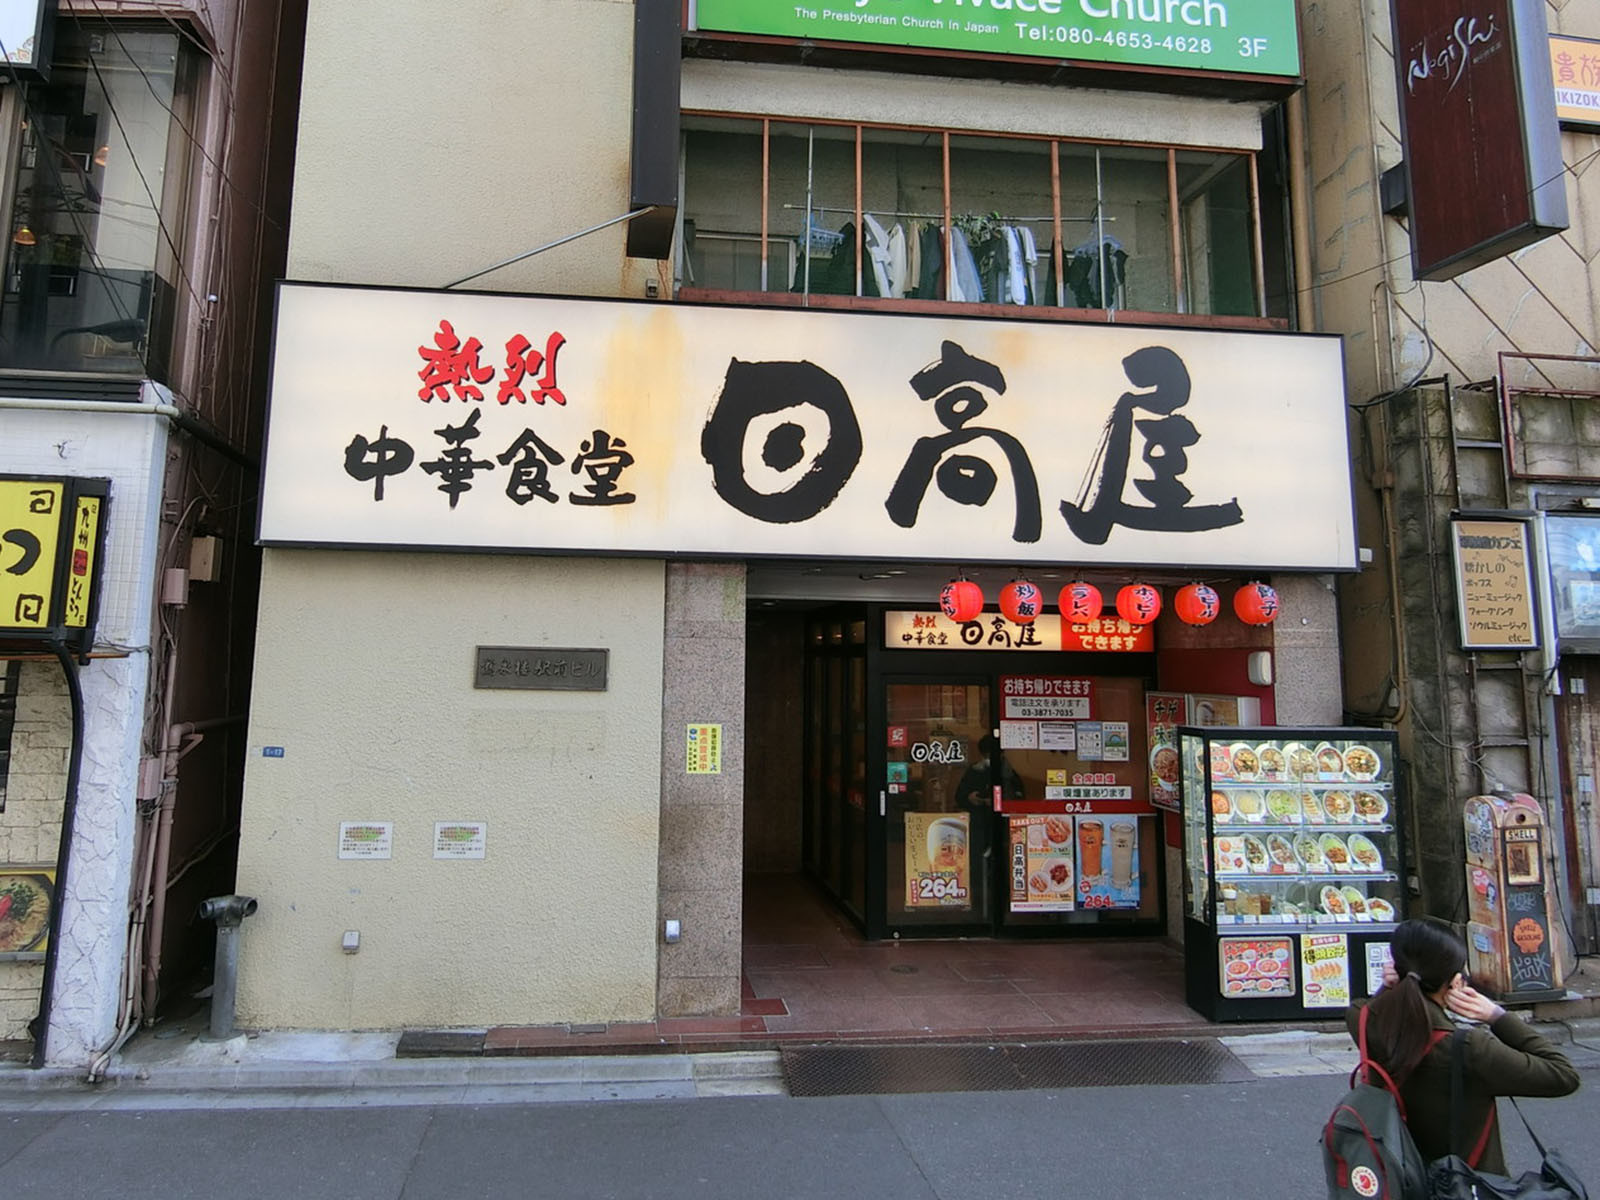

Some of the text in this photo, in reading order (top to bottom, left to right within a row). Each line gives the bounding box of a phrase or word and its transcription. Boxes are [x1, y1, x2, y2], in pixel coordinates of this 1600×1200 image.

[795, 7, 817, 20] The
[823, 10, 897, 26] Presbyterian
[902, 17, 944, 30] Church
[964, 21, 999, 34] Japan
[1015, 23, 1267, 57] Tel:080-4653-4628 3F
[418, 319, 566, 406] 熱烈
[700, 339, 1244, 546] 日高屋
[344, 408, 636, 511] 中華食堂
[1014, 584, 1036, 617] 炒飯
[1133, 586, 1154, 619] ホッピー
[1466, 593, 1523, 602] ニューミュージック
[902, 629, 949, 647] 中華食堂
[956, 616, 1043, 648] 日高屋
[1079, 634, 1138, 652] できます
[1004, 679, 1091, 695] お持ち帰りできます
[1021, 709, 1074, 717] 03-3871-7035
[911, 739, 965, 763] 日高屋
[1508, 829, 1534, 841] SHELL
